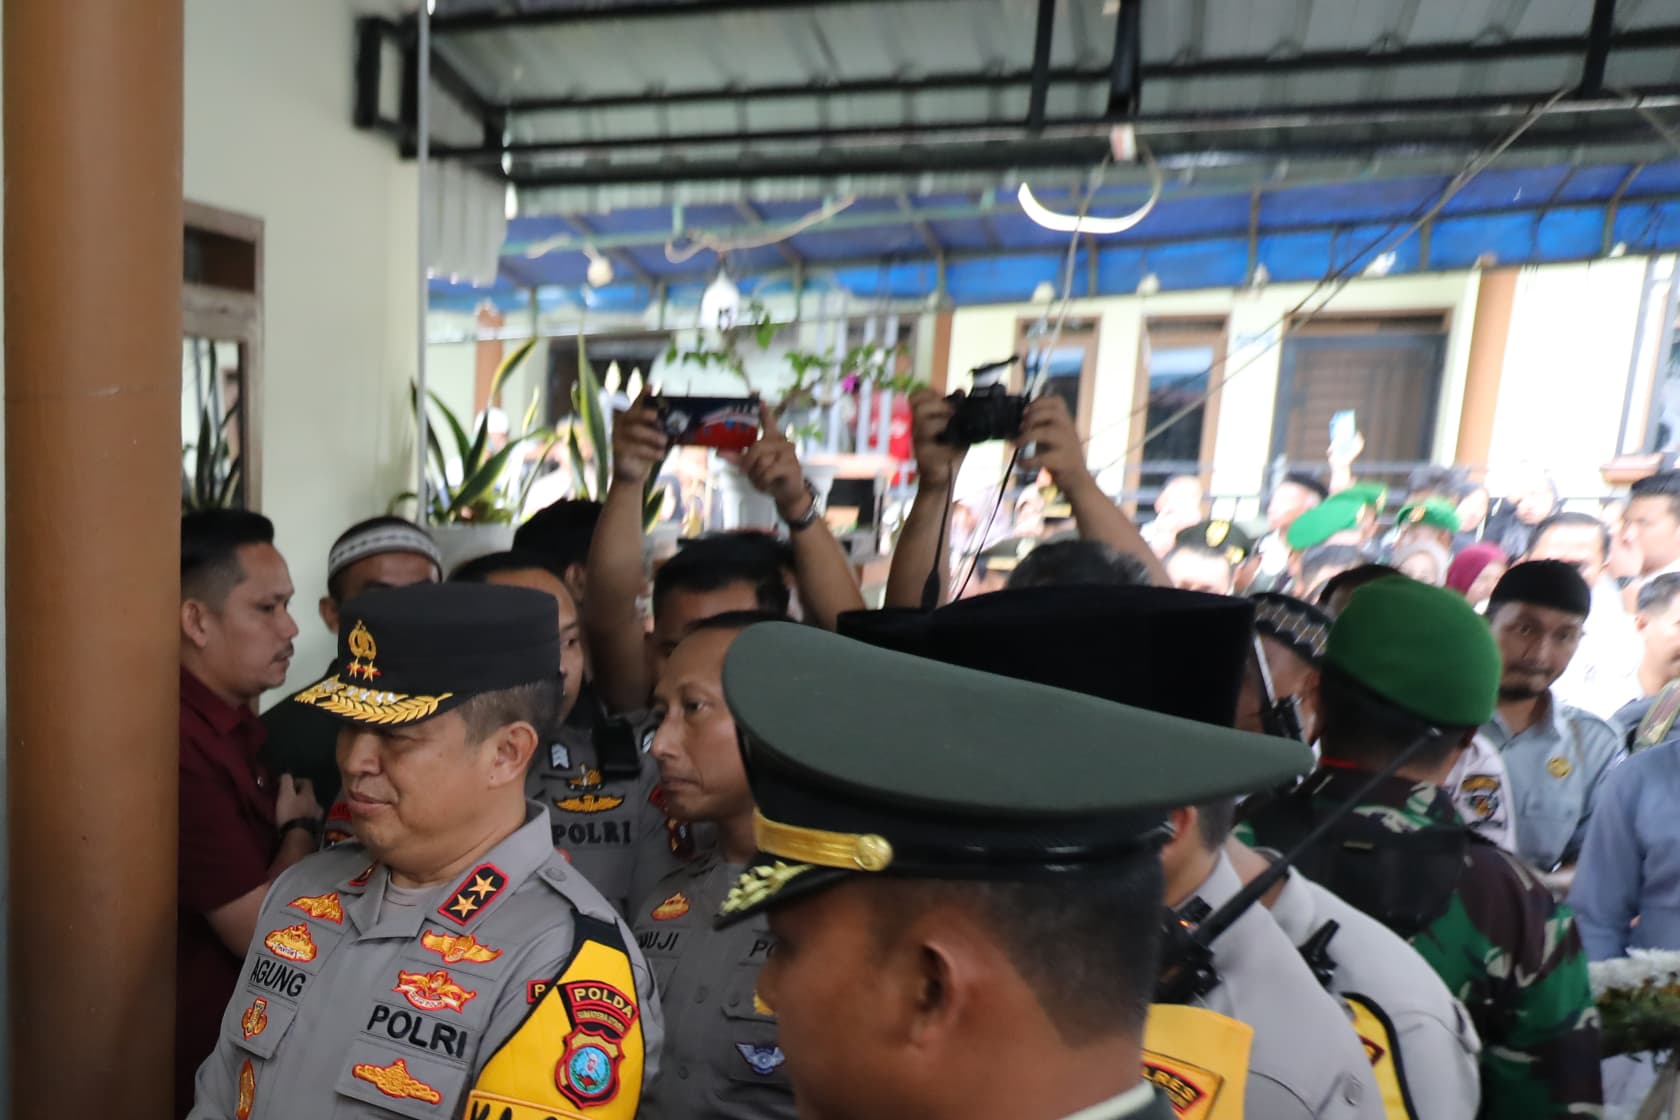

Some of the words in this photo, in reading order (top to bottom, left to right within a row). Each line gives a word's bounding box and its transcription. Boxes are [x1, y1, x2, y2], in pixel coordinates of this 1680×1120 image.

[551, 820, 631, 846] POLRI
[250, 956, 307, 997] AGUNG
[573, 987, 633, 1019] POLDA
[366, 1004, 468, 1059] POLRI
